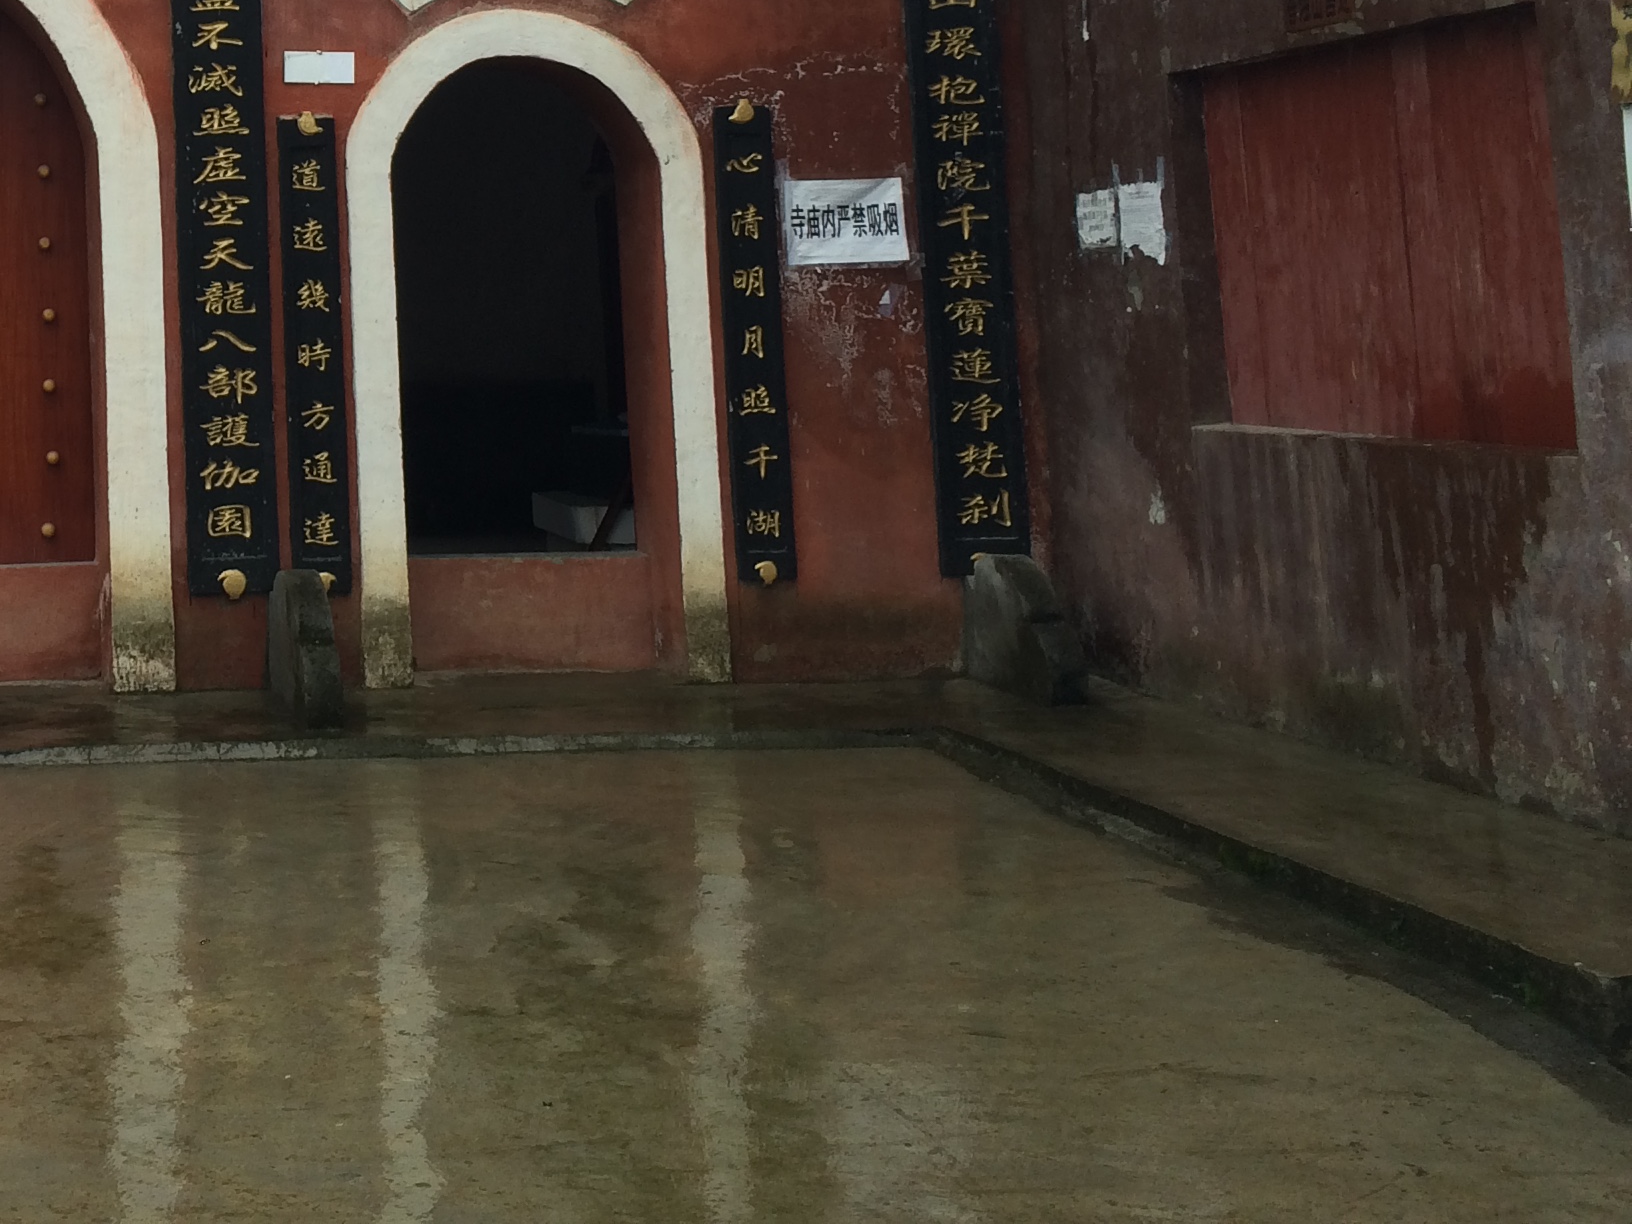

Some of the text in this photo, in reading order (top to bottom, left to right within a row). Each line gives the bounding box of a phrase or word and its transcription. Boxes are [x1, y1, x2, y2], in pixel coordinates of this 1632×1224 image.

[291, 159, 339, 546] 道遠幾時方通達
[726, 152, 781, 538] 心清明月照千湖
[791, 202, 899, 239] 寺庙内严禁吸烟
